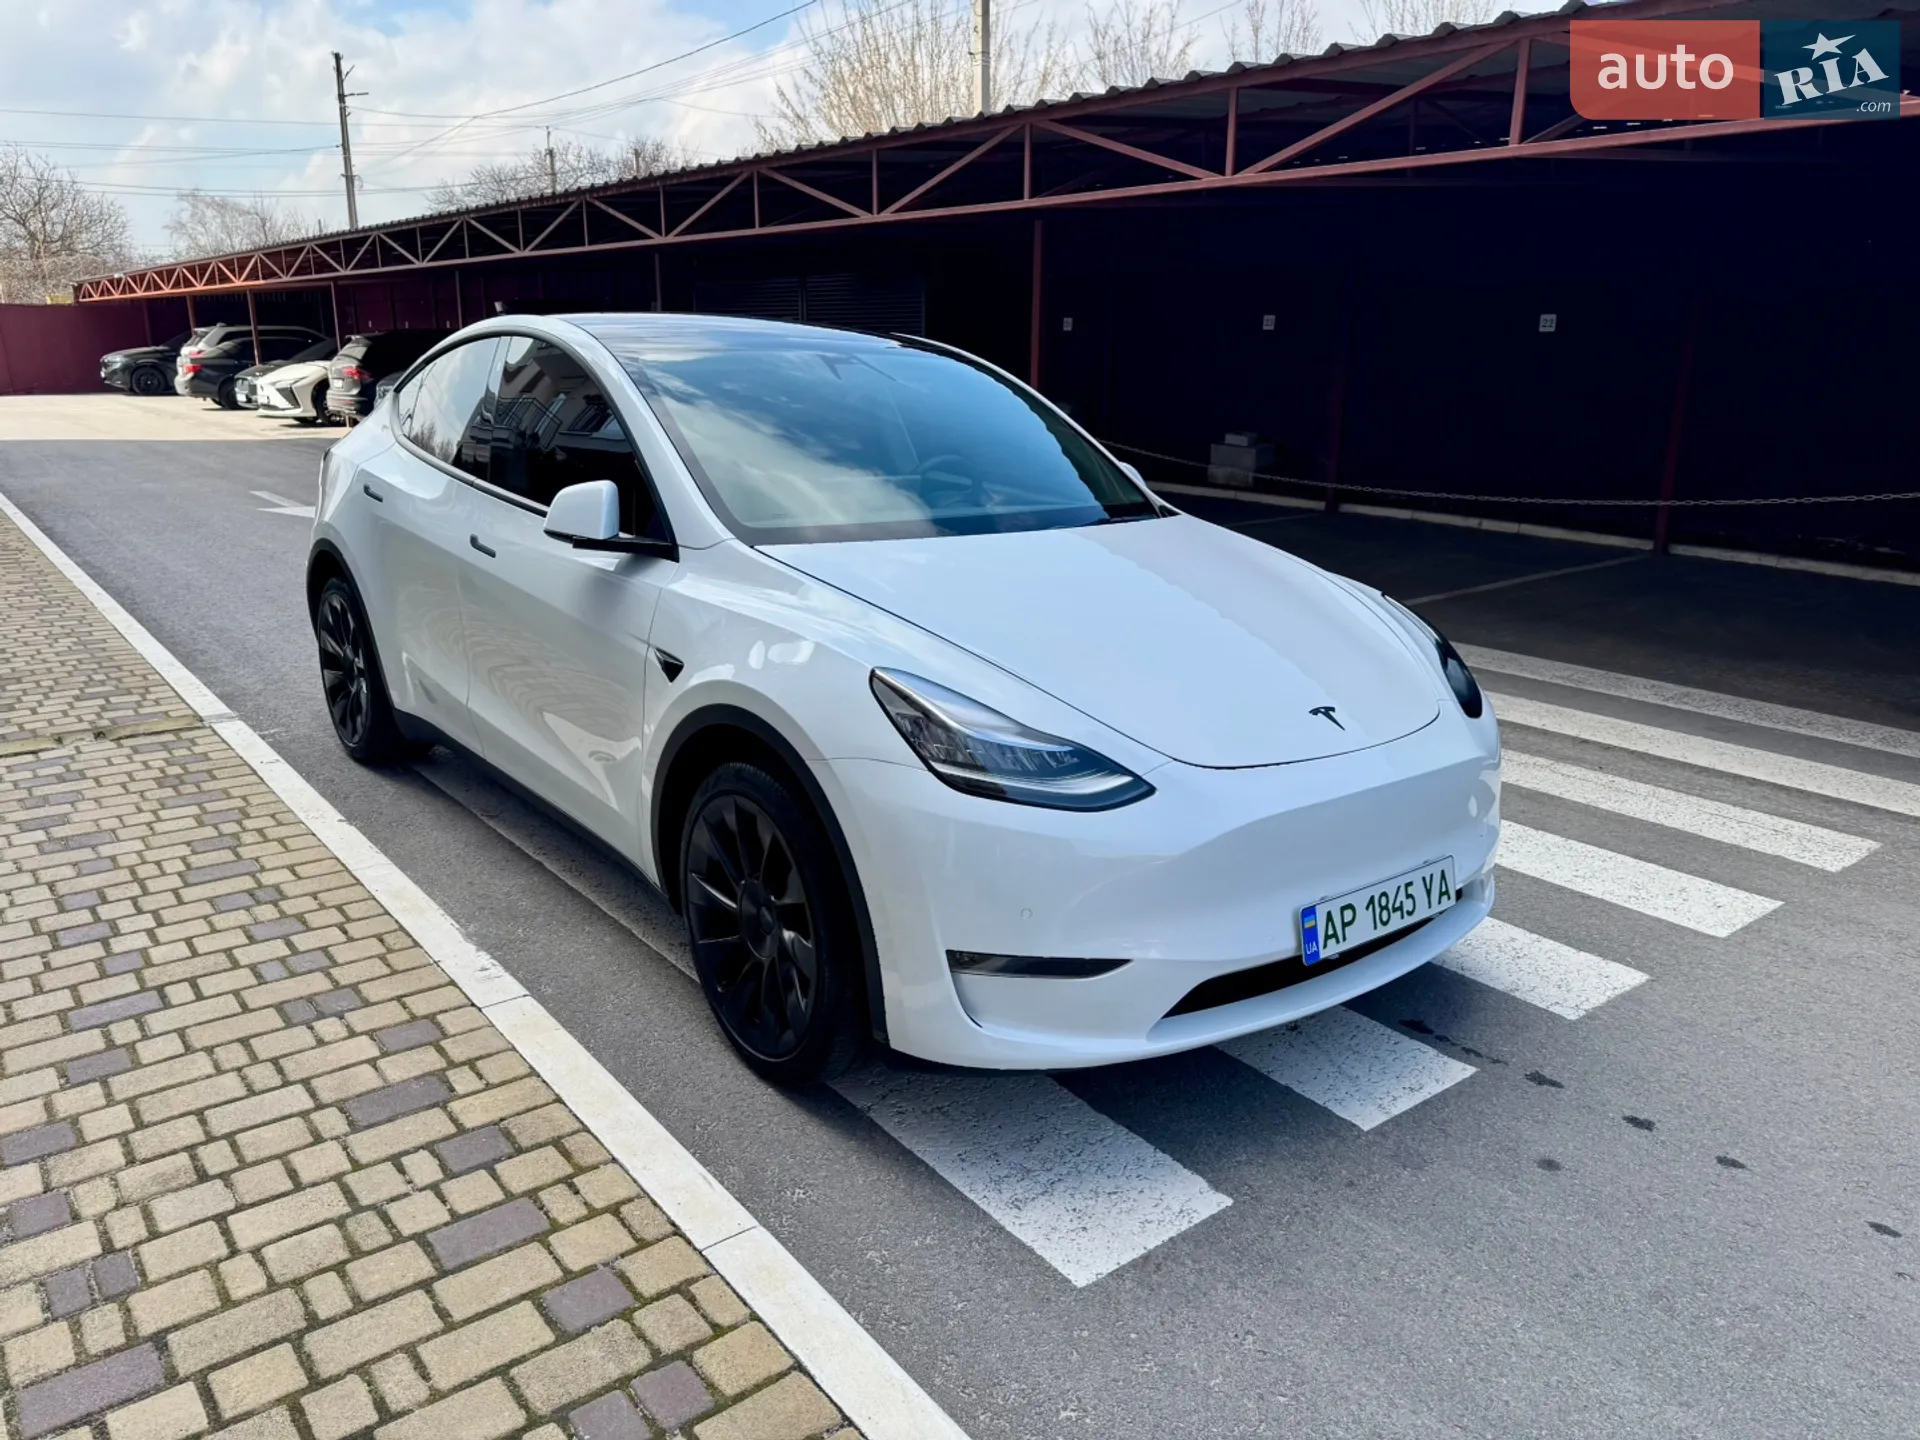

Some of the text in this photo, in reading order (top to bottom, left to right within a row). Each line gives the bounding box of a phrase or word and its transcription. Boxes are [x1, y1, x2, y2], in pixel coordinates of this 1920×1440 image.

[1323, 869, 1451, 950] AP 1845 YA
[1305, 941, 1318, 955] UA
